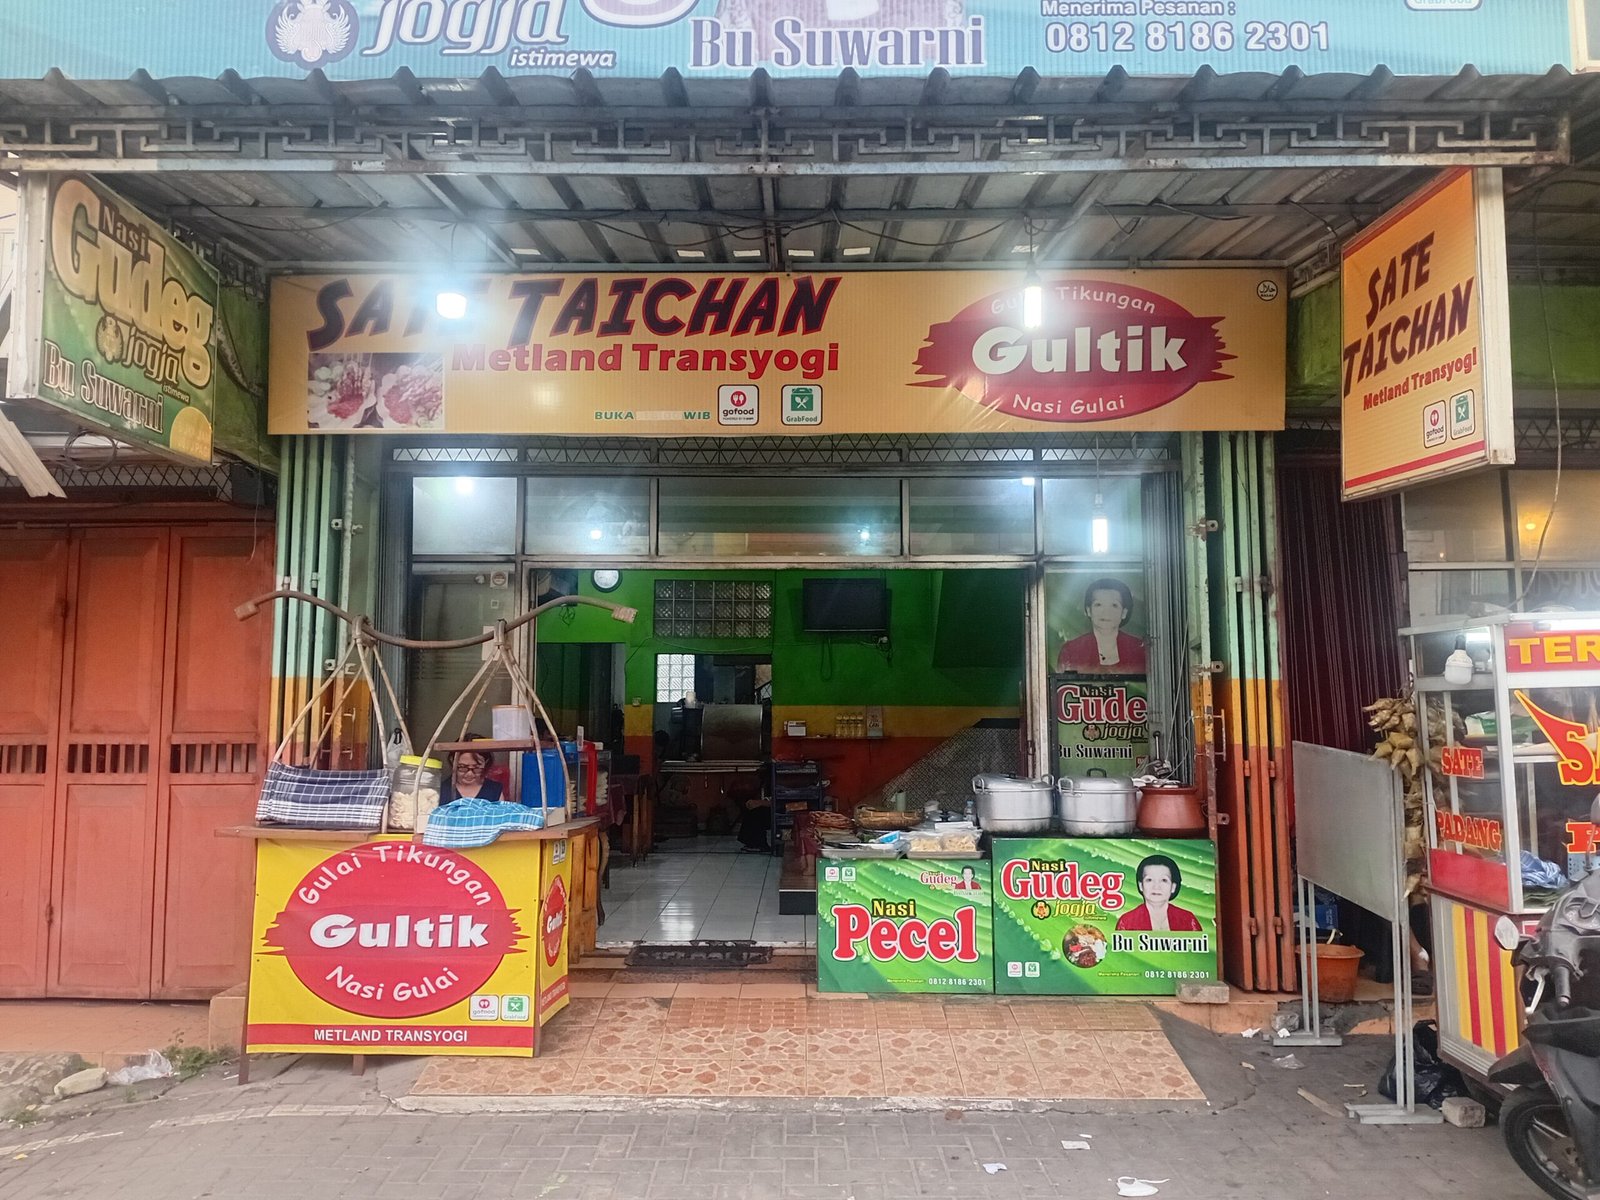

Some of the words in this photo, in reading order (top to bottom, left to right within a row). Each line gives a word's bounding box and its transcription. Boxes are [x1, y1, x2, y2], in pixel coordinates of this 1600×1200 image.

[1041, 0, 1136, 16] Menerima
[1140, 0, 1224, 15] Pesanan
[689, 17, 754, 67] Bu
[772, 15, 986, 67] Suwarni
[1045, 21, 1134, 52] 0812
[1145, 21, 1235, 51] 8186
[1244, 21, 1329, 51] 2301
[509, 49, 616, 67] istimewa
[102, 204, 150, 260] Nasi
[51, 178, 213, 387] Gudeg
[1366, 230, 1435, 330] SATE
[507, 275, 842, 349] TAICHAN
[1055, 285, 1155, 314] Tikungan
[971, 325, 1188, 375] Gultik
[1342, 277, 1475, 398] TAICHAN
[122, 325, 179, 384] jogja
[451, 342, 623, 373] Metland
[632, 342, 839, 380] Transyogi
[43, 339, 75, 396] Bu
[81, 360, 163, 433] Suwarni
[163, 384, 190, 403] istimewa
[1363, 376, 1410, 411] Metland
[1411, 347, 1477, 390] Transyogi
[594, 411, 634, 420] BUKA
[683, 411, 711, 420] WIB
[722, 408, 754, 417] gofood
[1012, 394, 1062, 414] Nasi
[1070, 395, 1126, 414] Gulai
[1508, 635, 1600, 664] TER
[1057, 685, 1148, 724] Gude
[1082, 686, 1112, 696] Nasi
[1101, 724, 1143, 740] jogja
[1076, 744, 1133, 759] Suwarni
[1441, 746, 1484, 779] SATE
[1436, 810, 1502, 852] PADANG
[298, 852, 362, 905] Gulai
[372, 844, 492, 906] Tikungan
[1030, 860, 1065, 872] Nasi
[1001, 859, 1125, 911] Gudeg
[872, 899, 916, 917] Nasi
[1053, 900, 1096, 917] jogja
[309, 913, 490, 948] Gultik
[831, 904, 980, 962] Pecel
[1111, 934, 1134, 953] Bu
[1139, 934, 1209, 953] Suwarni
[325, 965, 384, 1001] Nasi
[392, 967, 460, 1002] Gulai
[968, 978, 986, 986] 2301
[1144, 970, 1165, 978] 0812
[1189, 971, 1209, 979] 2301
[313, 1028, 381, 1042] METLAND
[385, 1029, 468, 1042] TRANSYOGI
